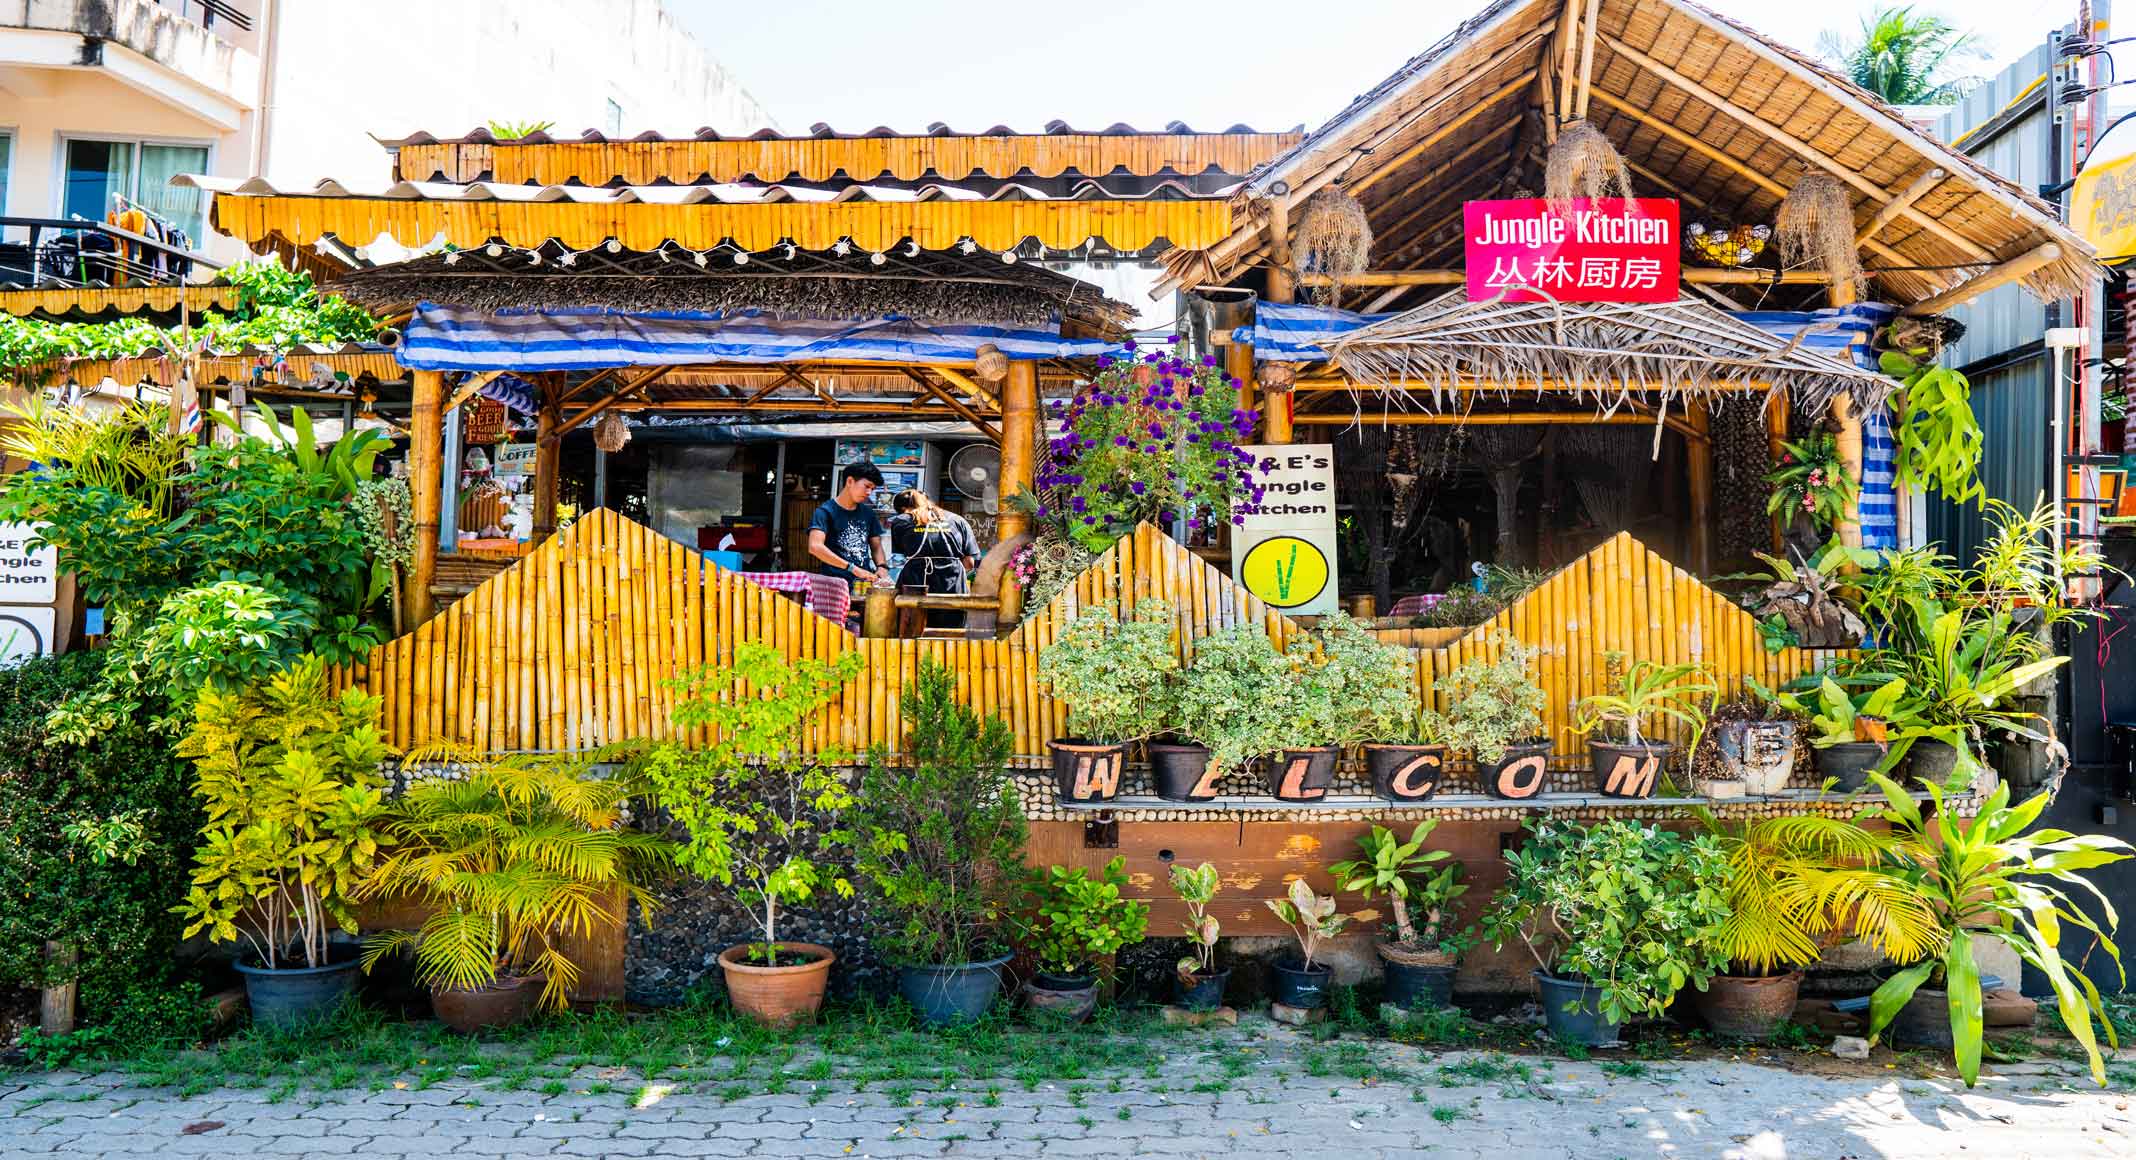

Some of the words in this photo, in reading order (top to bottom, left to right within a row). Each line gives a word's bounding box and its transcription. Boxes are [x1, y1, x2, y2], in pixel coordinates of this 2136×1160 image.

[1475, 211, 1565, 249] Jungle
[1576, 210, 1669, 245] Kitchen
[1484, 255, 1663, 289] 丛林厨房
[468, 412, 502, 426] BEER
[498, 449, 537, 462] COFFE
[1287, 454, 1329, 469] E's
[1250, 480, 1327, 495] ungle
[0, 557, 42, 568] ngle
